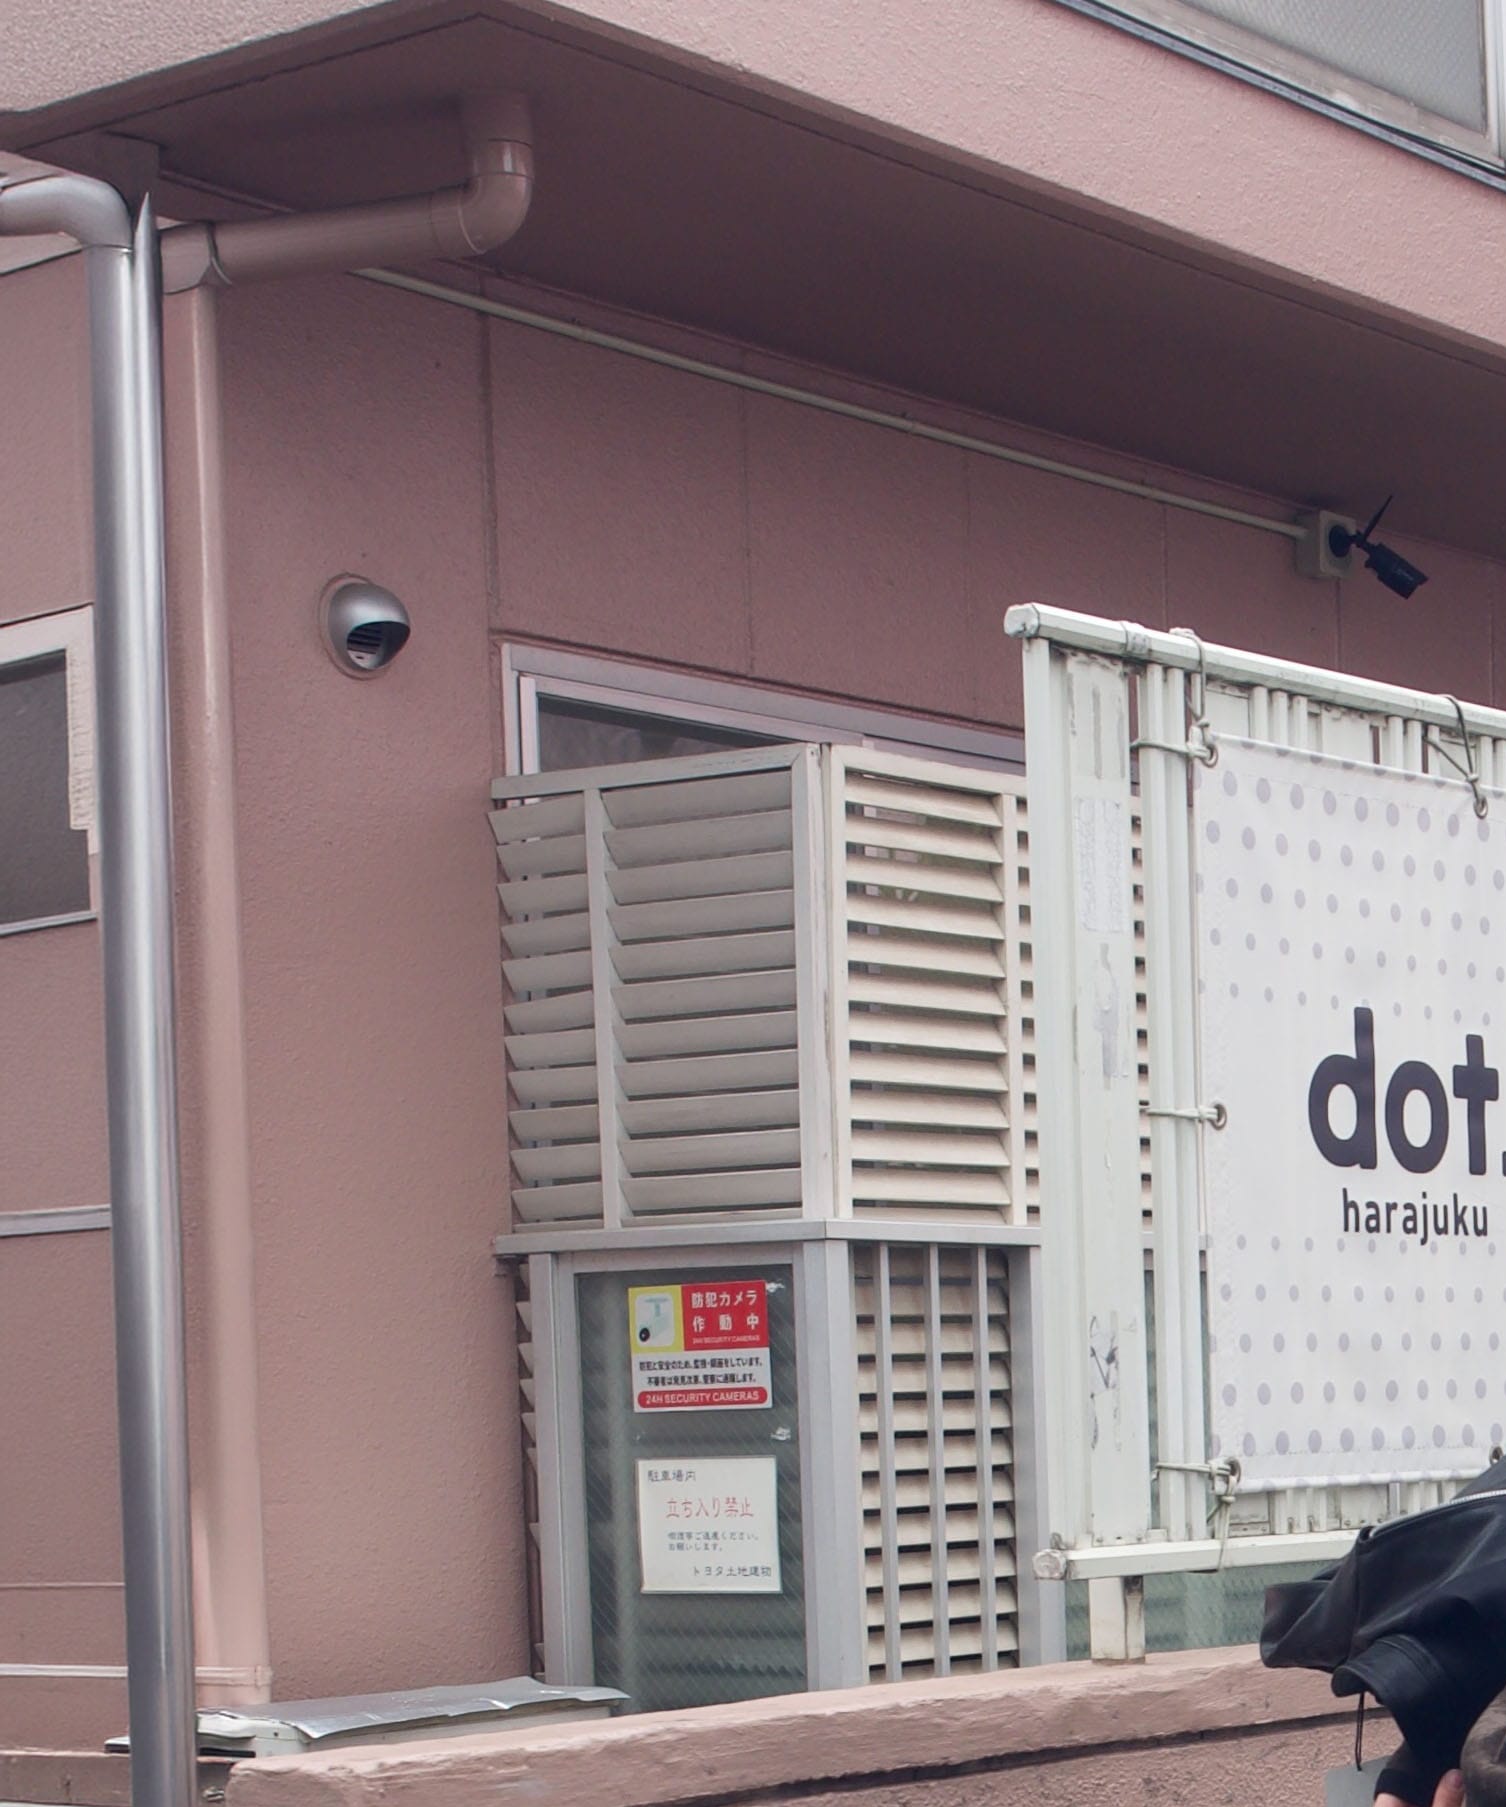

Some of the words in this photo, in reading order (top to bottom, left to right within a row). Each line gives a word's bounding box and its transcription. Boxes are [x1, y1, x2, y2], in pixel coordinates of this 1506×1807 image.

[1342, 1188, 1489, 1245] harajuku
[691, 1290, 757, 1308] 防犯カメラ
[646, 1394, 663, 1405] 24H
[664, 1392, 711, 1404] SECURITY
[712, 1391, 759, 1401] CAMERAS
[648, 1470, 696, 1482] 駐車場内
[666, 1497, 754, 1518] 立ち入り禁止
